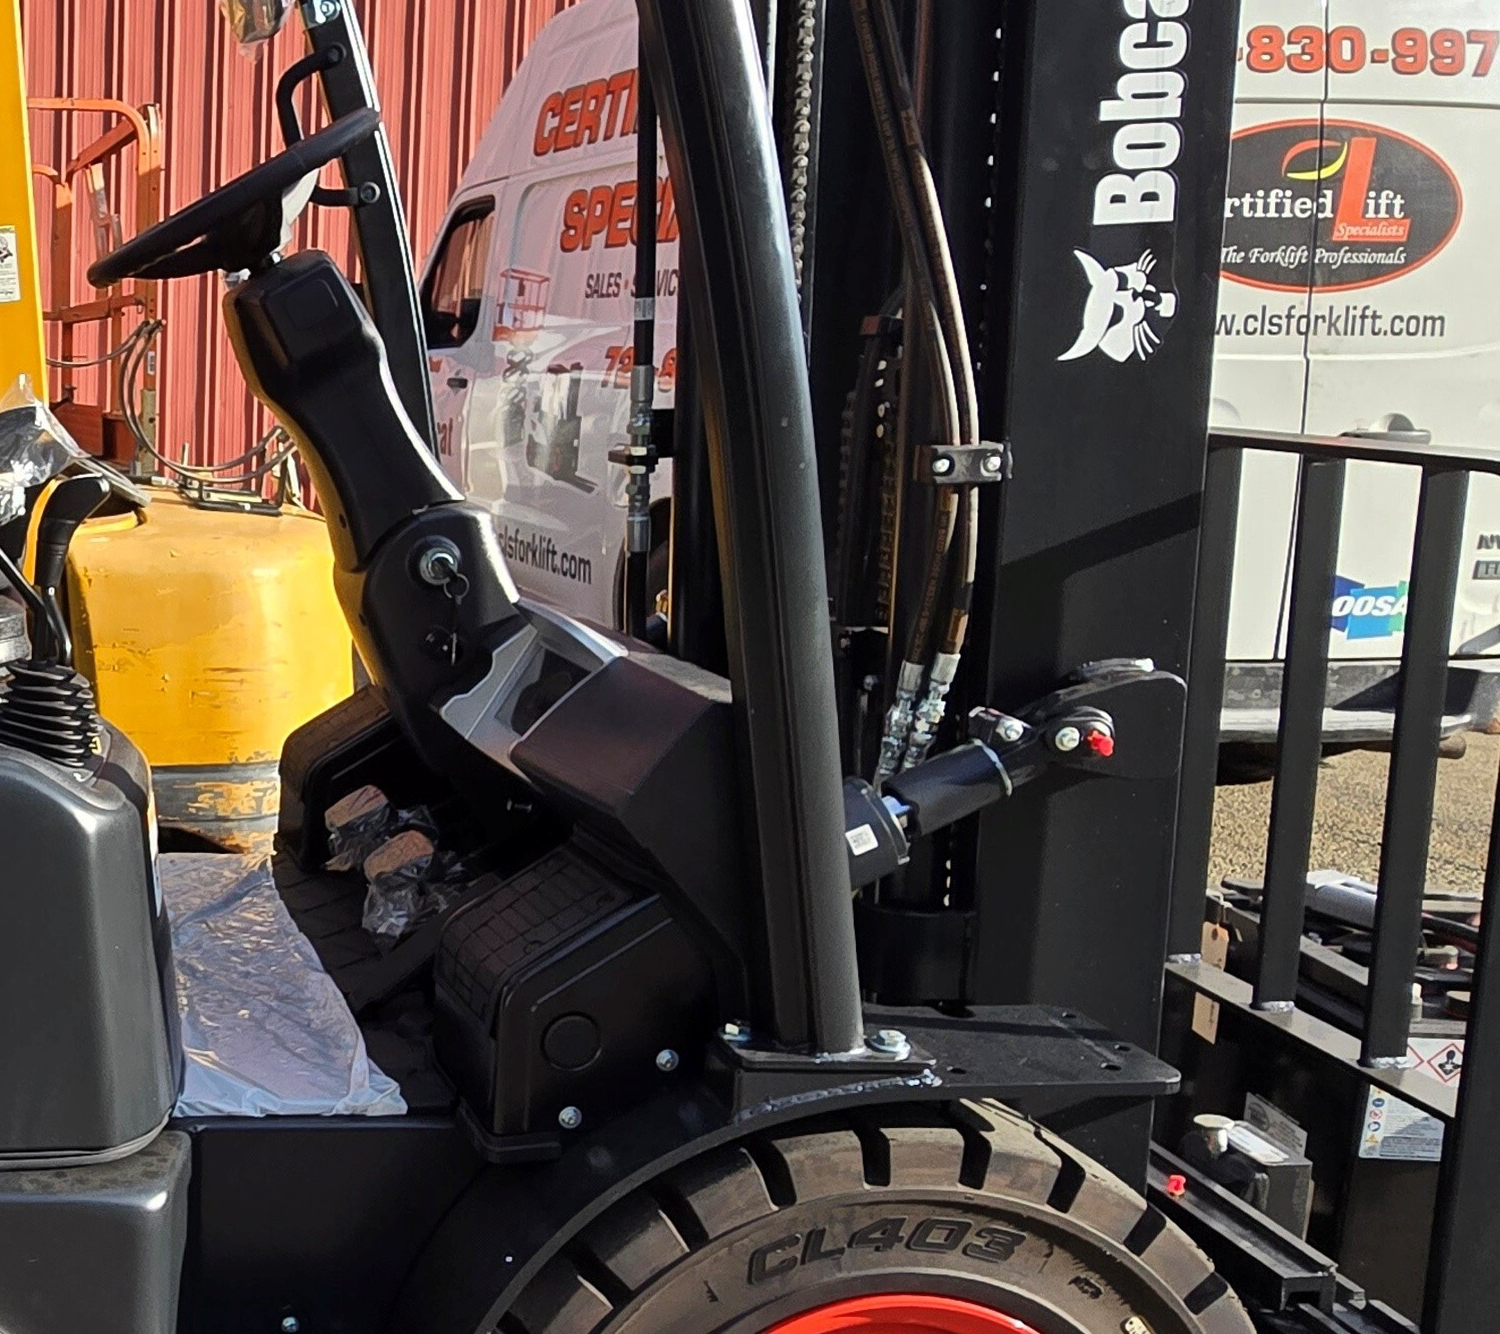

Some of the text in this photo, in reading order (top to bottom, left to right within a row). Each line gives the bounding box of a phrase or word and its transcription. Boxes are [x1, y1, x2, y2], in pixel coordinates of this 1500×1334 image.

[534, 68, 639, 156] CERTI
[1224, 189, 1333, 219] rtified
[1336, 222, 1406, 239] Specialists
[1248, 245, 1309, 269] Forklift
[1314, 246, 1407, 269] Professionals
[585, 272, 622, 299] SALES
[1214, 304, 1446, 337] w.clsforklift.com
[1331, 595, 1408, 617] OOSA
[747, 1216, 1028, 1286] CL403
